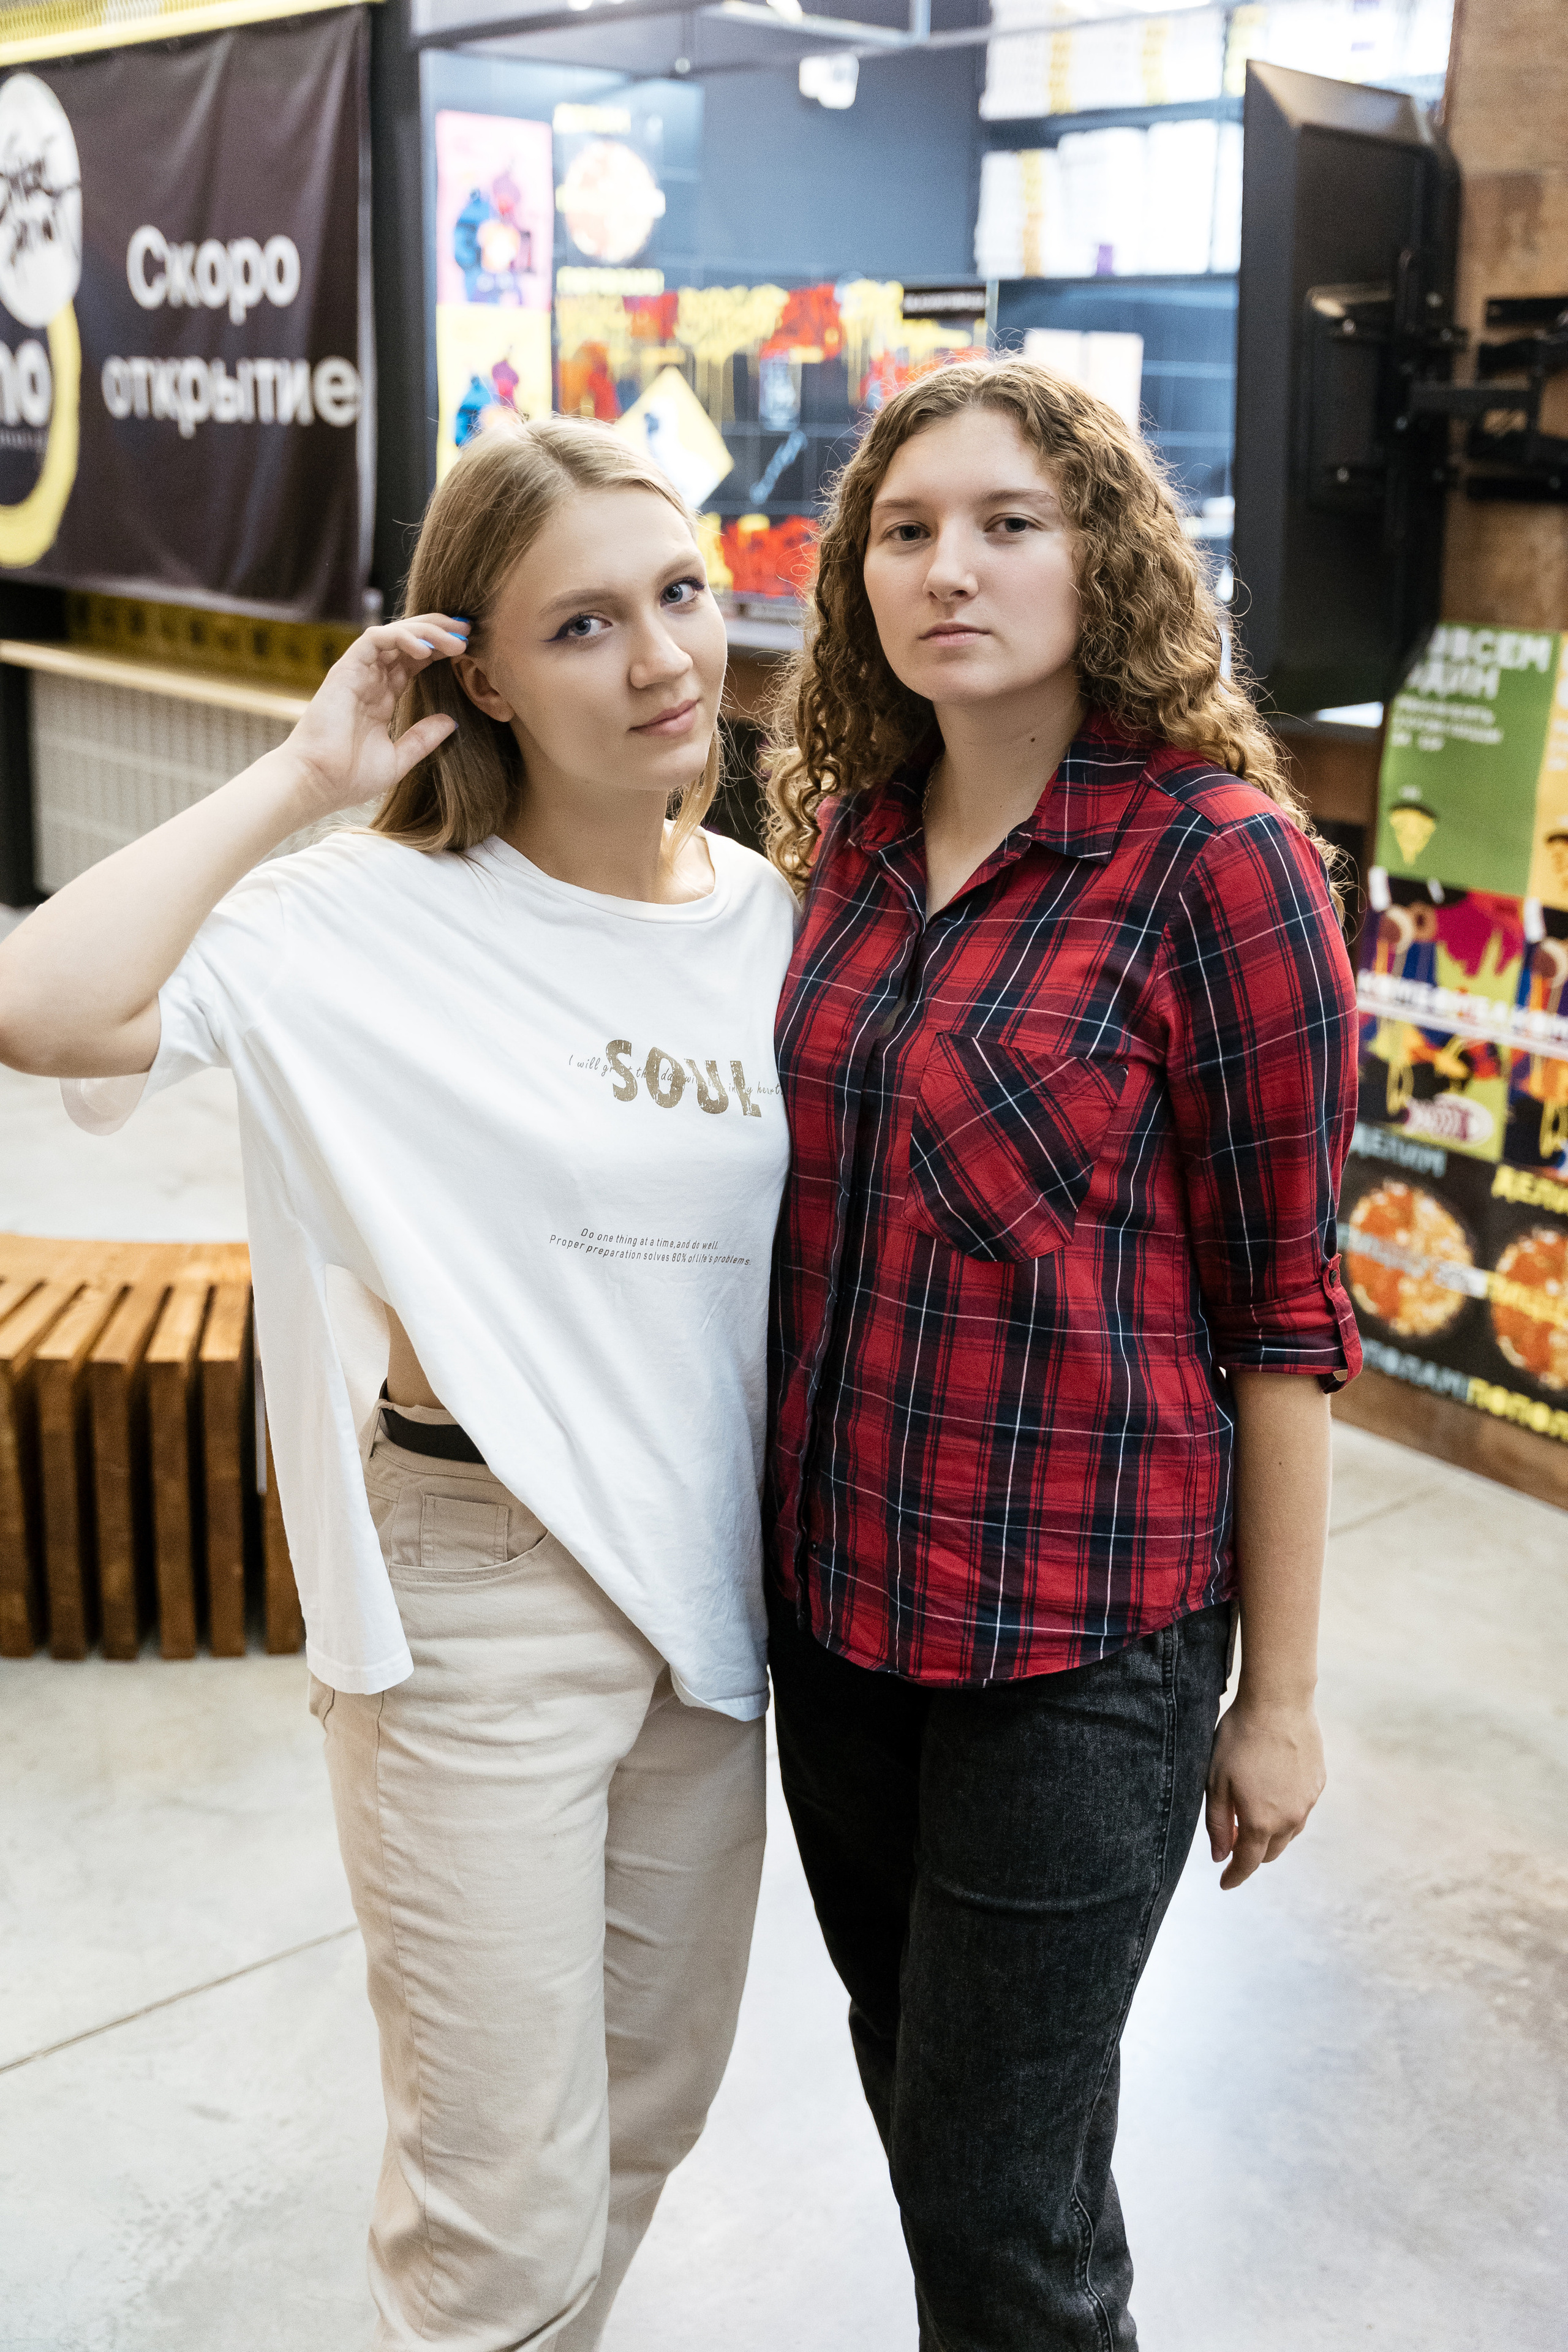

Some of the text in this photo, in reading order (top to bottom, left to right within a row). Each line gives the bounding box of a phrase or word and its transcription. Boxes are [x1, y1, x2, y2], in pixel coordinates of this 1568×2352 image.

[126, 224, 301, 326] Скоро
[102, 355, 360, 439] открытие
[577, 1057, 601, 1070] will
[606, 1039, 762, 1117] SOUL
[549, 1234, 585, 1250] Proper
[586, 1245, 641, 1259] preparation
[644, 1252, 669, 1262] solves
[672, 1253, 686, 1262] 80%
[713, 1255, 751, 1265] problems.
[581, 1228, 594, 1238] Do
[597, 1234, 613, 1242] one
[616, 1234, 637, 1247] thing
[640, 1237, 648, 1246] at
[692, 1240, 699, 1249] do
